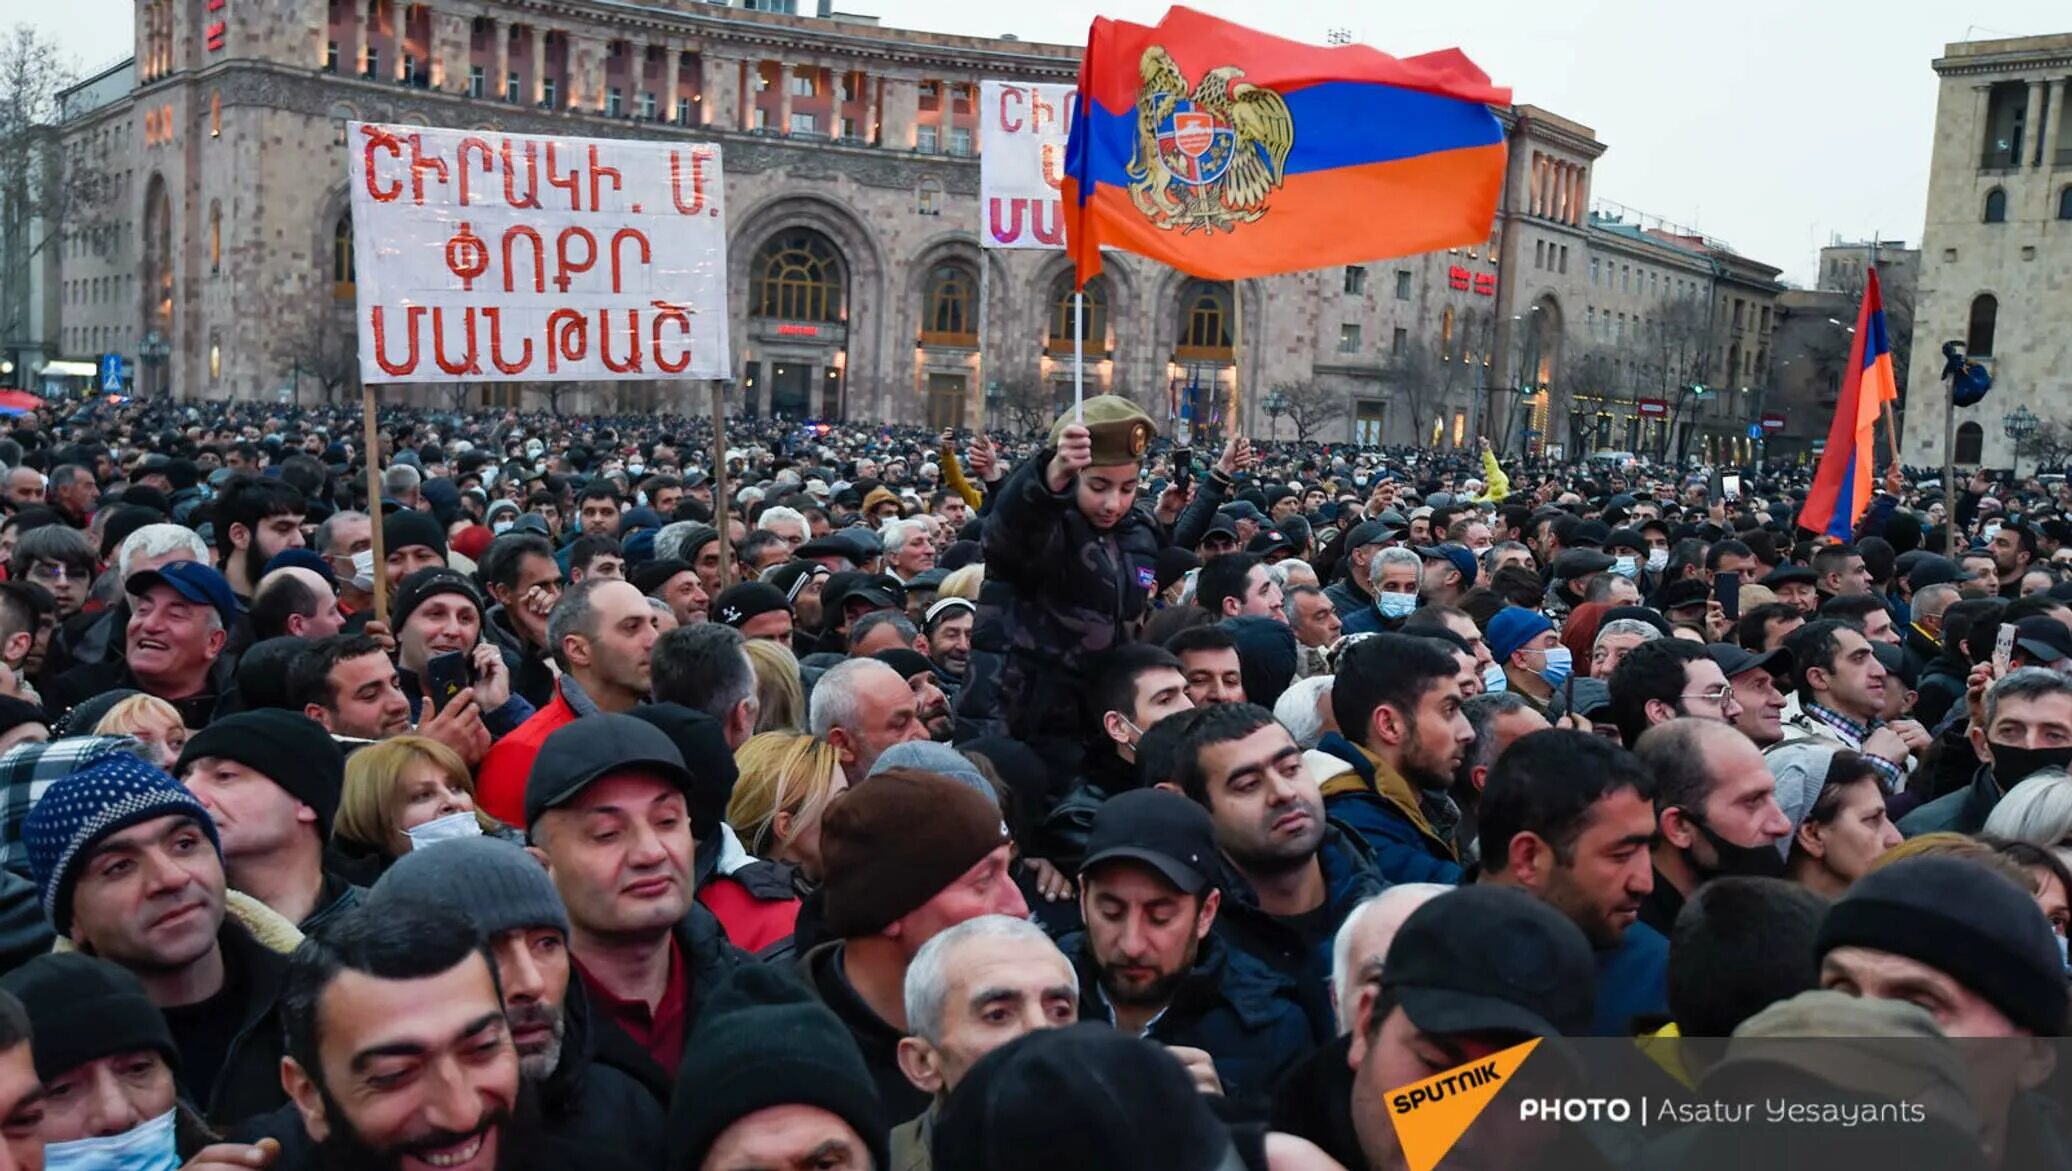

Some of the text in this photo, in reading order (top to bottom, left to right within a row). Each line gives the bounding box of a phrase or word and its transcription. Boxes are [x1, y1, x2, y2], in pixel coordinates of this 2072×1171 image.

[361, 124, 719, 217] ՇԻՐԱԿԻ. Մ.
[444, 222, 652, 294] ՓՈՔՐ
[989, 197, 1065, 246] ՄԱ
[371, 300, 697, 376] ՄԱՆԹԱՇ
